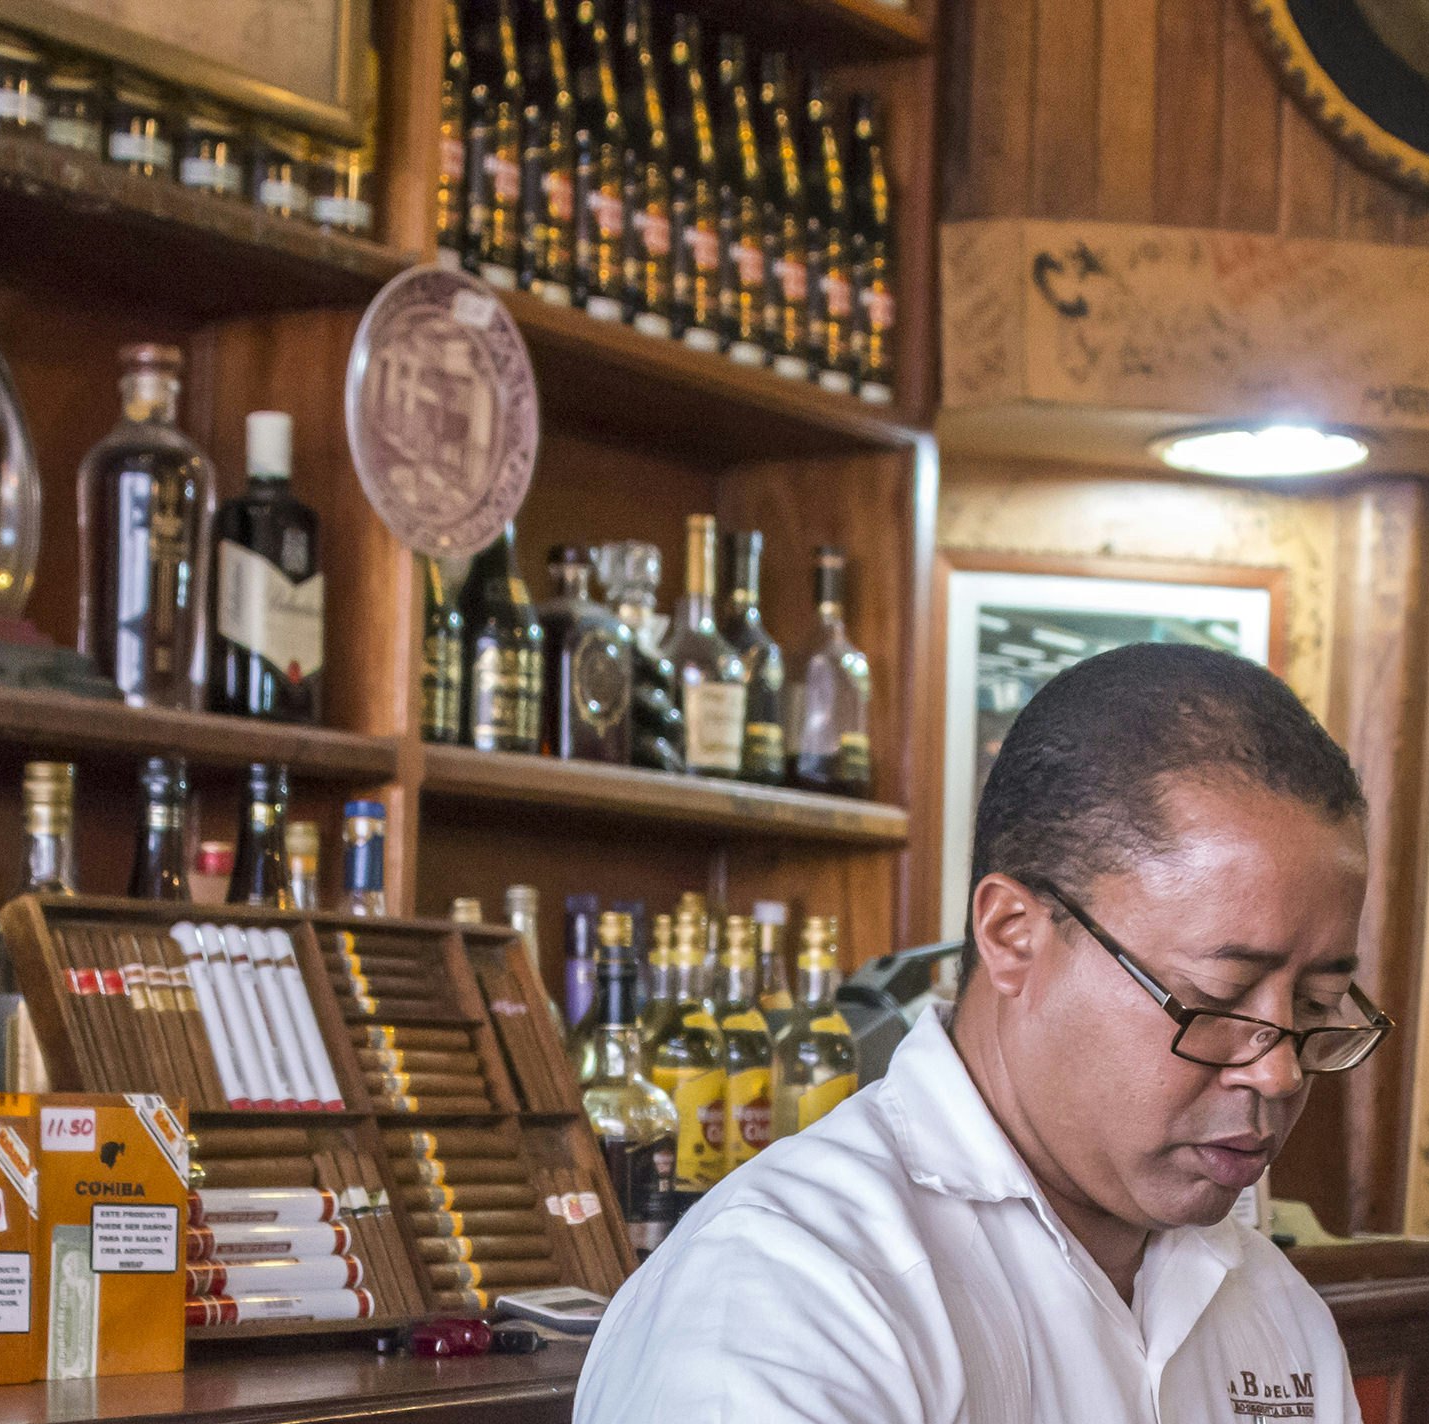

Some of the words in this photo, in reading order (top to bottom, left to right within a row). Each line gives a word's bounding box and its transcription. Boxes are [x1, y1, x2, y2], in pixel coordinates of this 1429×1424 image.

[47, 1118, 94, 1138] 11.50
[75, 1180, 147, 1198] COHIBA
[123, 1211, 167, 1219] PRODUCTO
[95, 1223, 121, 1231] PUEDE
[135, 1235, 162, 1243] SALUD
[1240, 1371, 1259, 1397] B
[1264, 1384, 1291, 1398] DEL
[1290, 1373, 1314, 1398] M
